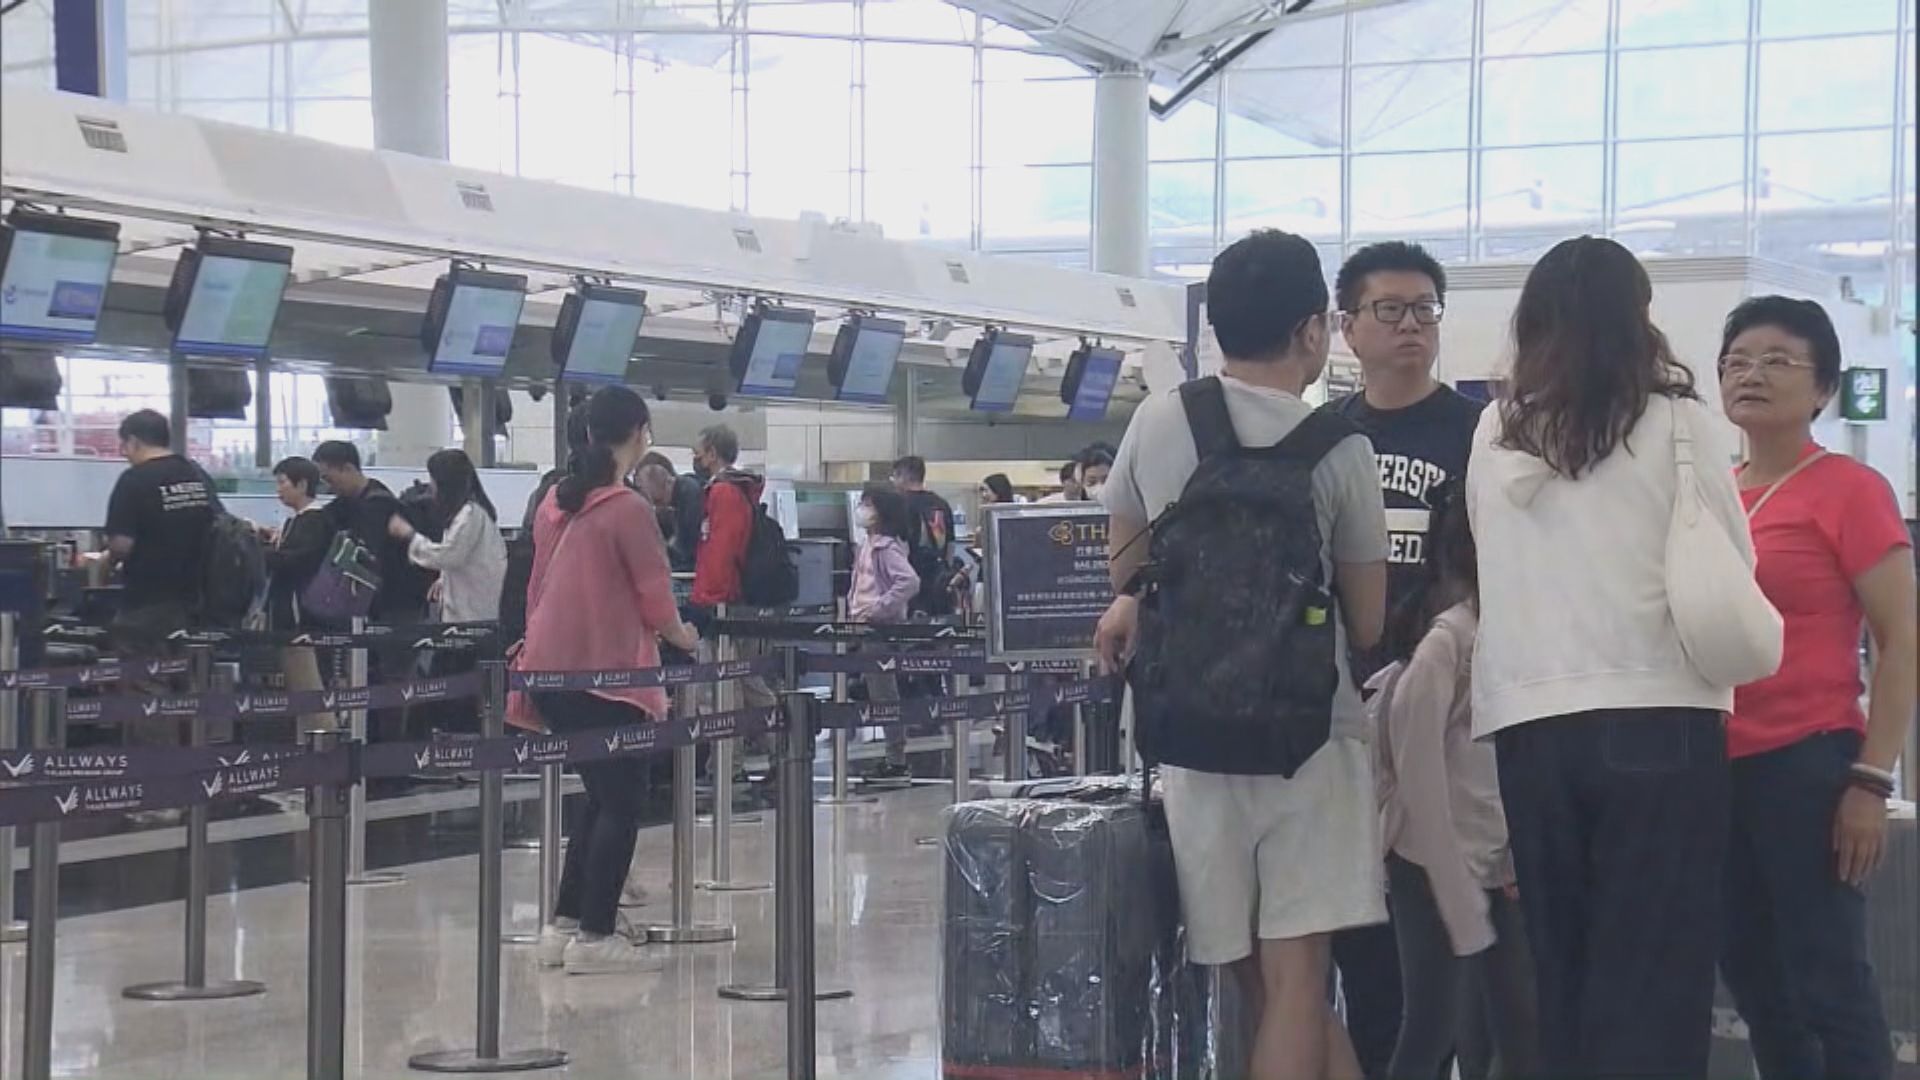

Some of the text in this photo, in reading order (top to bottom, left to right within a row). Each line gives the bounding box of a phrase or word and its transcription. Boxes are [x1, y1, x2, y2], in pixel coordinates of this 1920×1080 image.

[1075, 523, 1108, 541] TH
[901, 658, 952, 668] ALLWAYS
[434, 747, 474, 760] ALLWAYS
[44, 755, 129, 769] ALLWAYS
[228, 765, 281, 784] ALLWAYS
[84, 783, 144, 802] ALLWAYS
